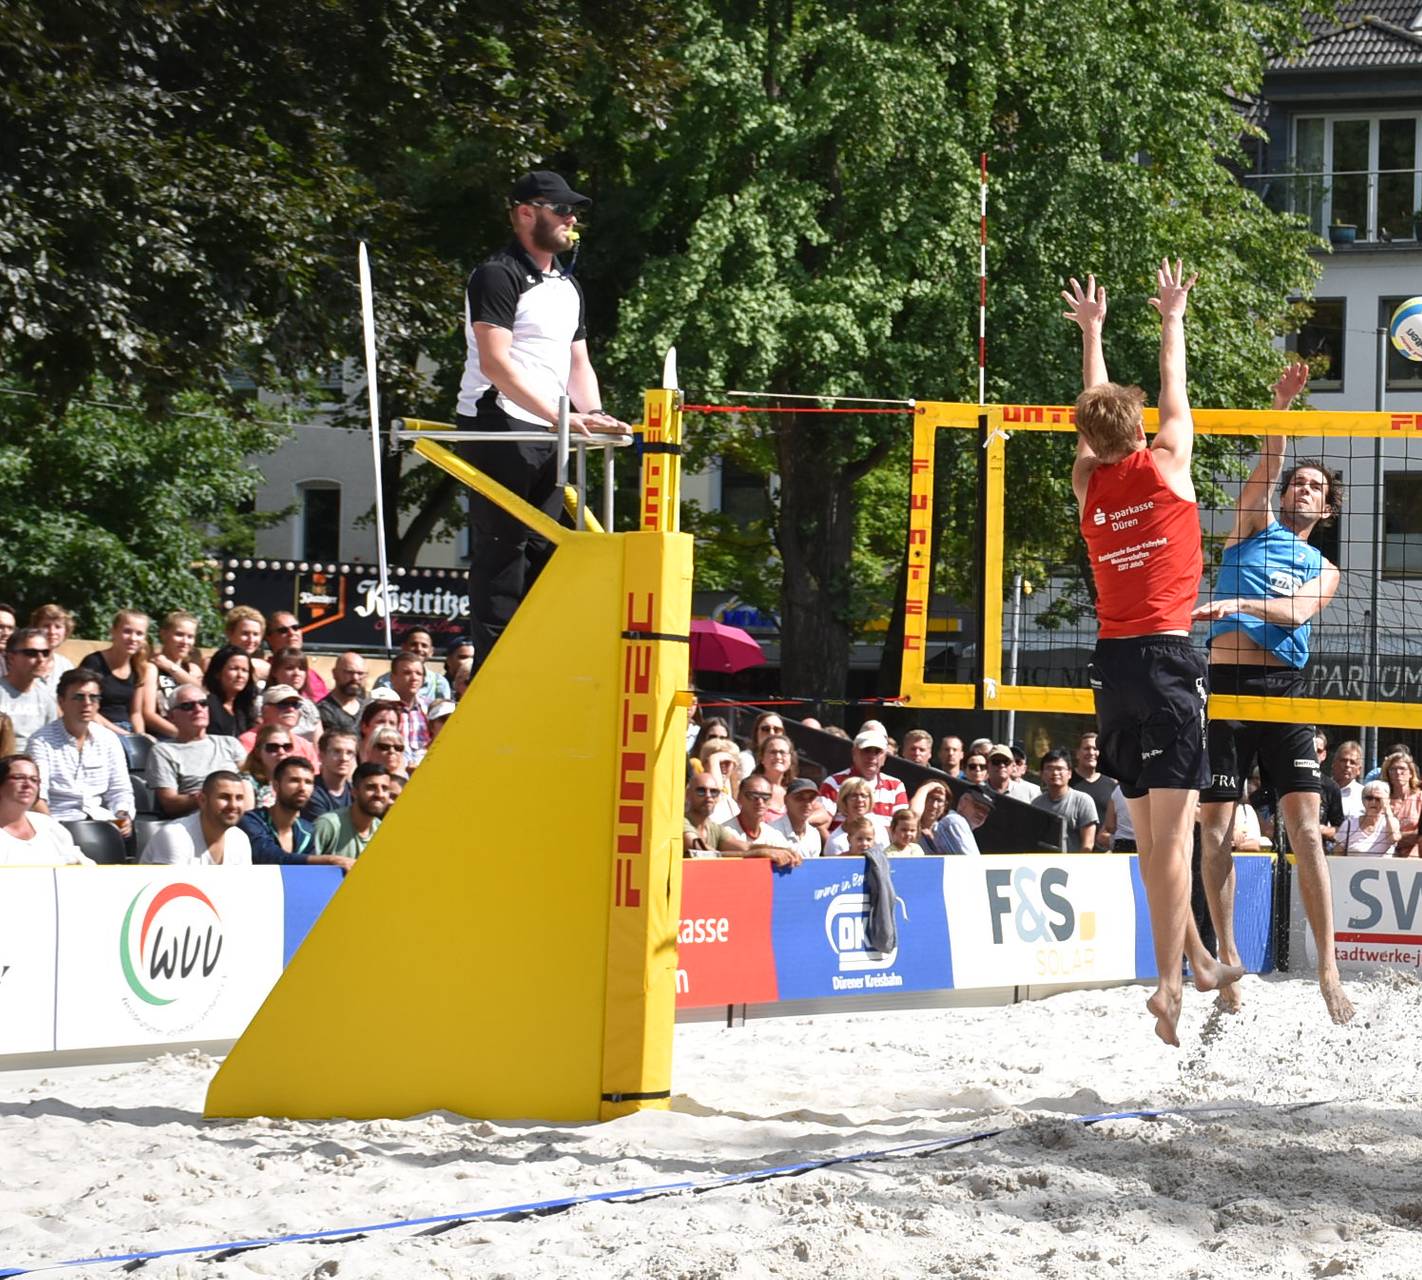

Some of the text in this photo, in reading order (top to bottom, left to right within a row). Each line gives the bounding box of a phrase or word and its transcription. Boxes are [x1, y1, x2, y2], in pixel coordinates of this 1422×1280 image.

[1109, 501, 1154, 521] Sparkasse
[1112, 518, 1139, 532] Düren
[903, 459, 930, 651] FUNTEC
[357, 580, 470, 622] Köstritze
[615, 592, 653, 907] FUNTEC
[985, 866, 1075, 945] F&S
[1035, 948, 1095, 977] SOLAR
